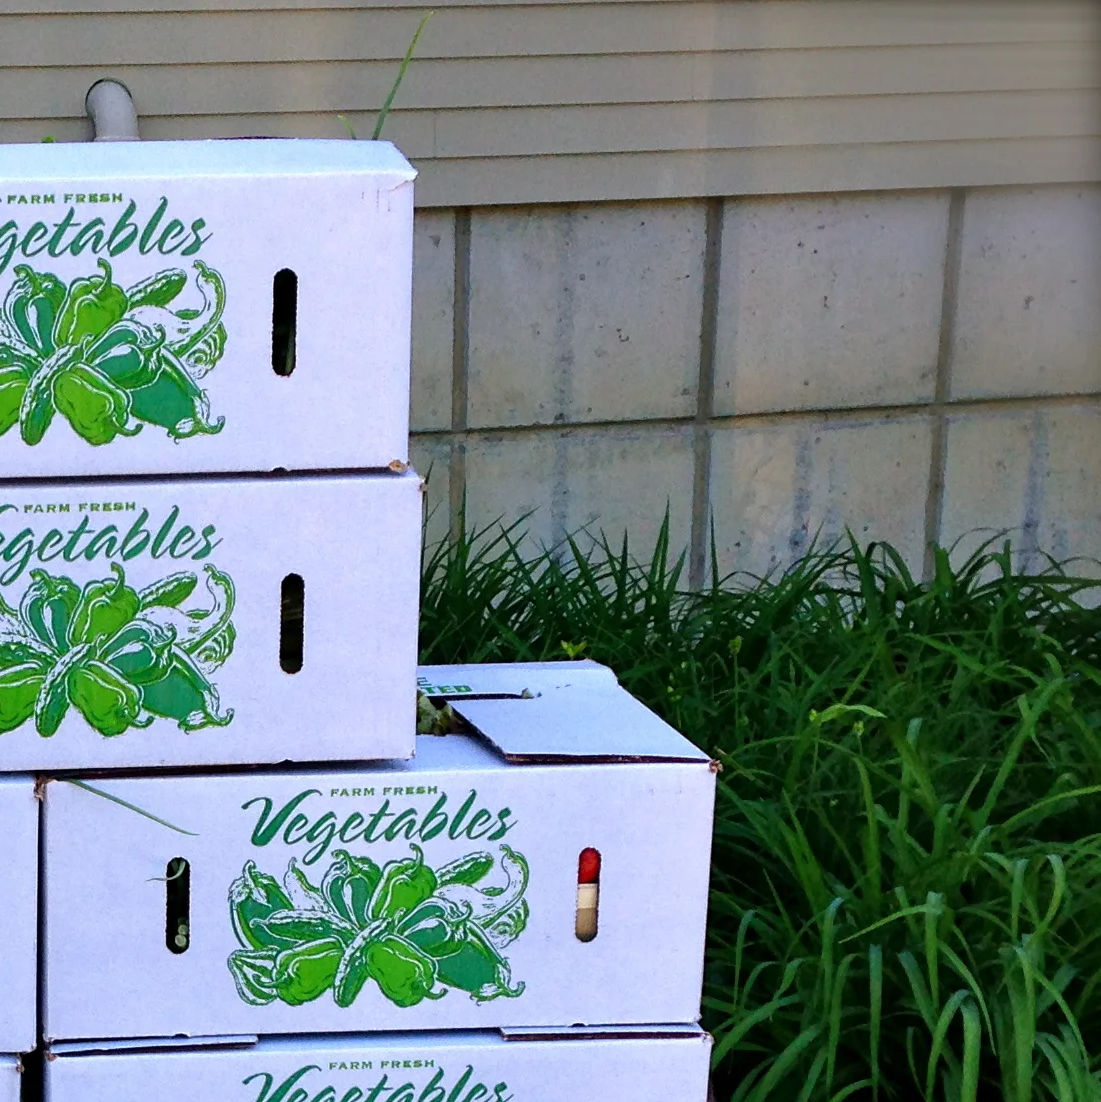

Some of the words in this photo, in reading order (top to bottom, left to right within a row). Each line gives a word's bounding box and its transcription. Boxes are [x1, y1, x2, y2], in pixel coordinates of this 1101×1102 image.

[7, 194, 55, 204] FARM
[63, 193, 123, 203] FRESH
[24, 503, 70, 513] FARM
[78, 502, 136, 512] FRESH
[330, 787, 375, 797] FARM
[382, 786, 438, 796] FRESH
[241, 788, 518, 866] Vegetables
[328, 1061, 373, 1070] FARM
[380, 1059, 435, 1069] FRESH
